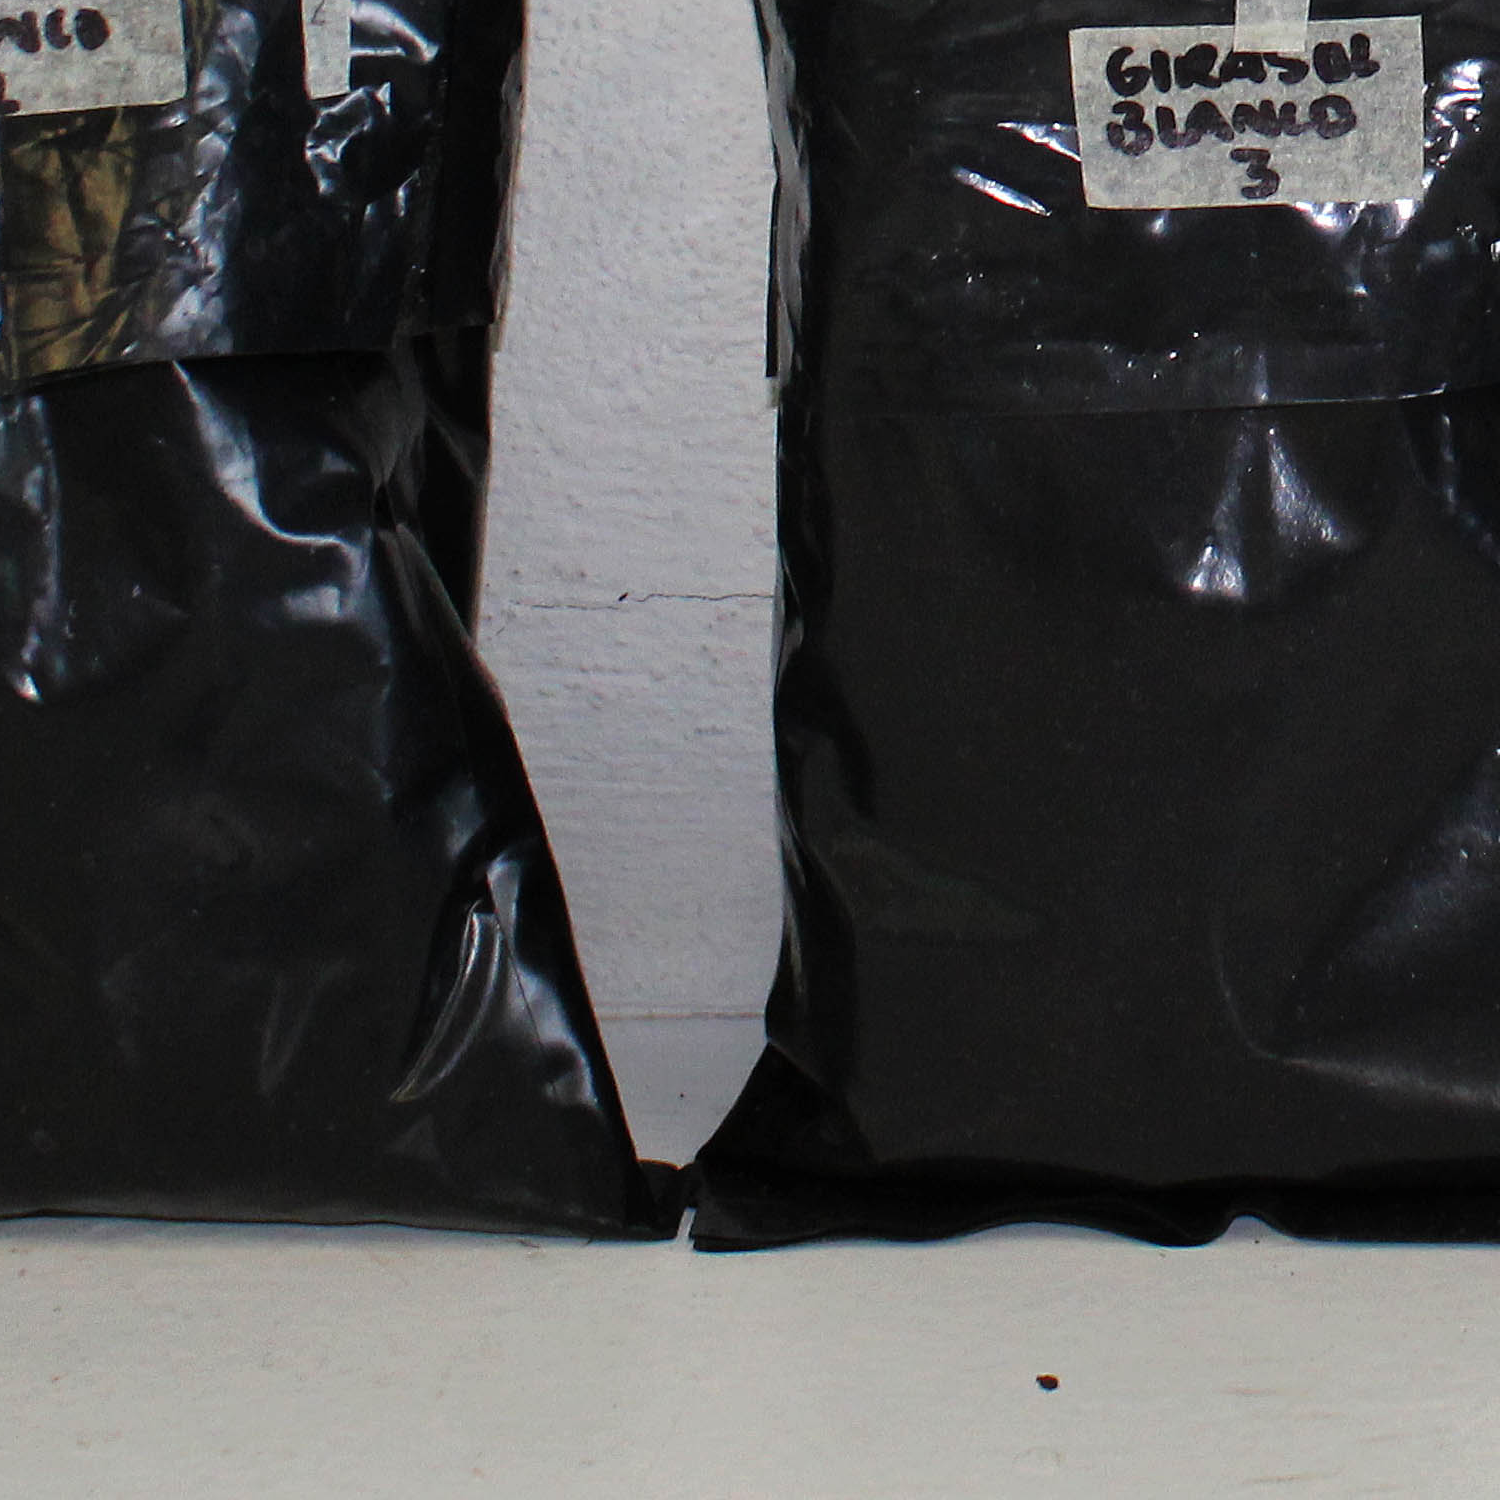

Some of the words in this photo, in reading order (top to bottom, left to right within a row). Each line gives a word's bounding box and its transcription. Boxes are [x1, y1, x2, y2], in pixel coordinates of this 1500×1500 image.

[1106, 33, 1380, 97] GIRASOL
[1106, 94, 1357, 156] BLANCO
[1230, 147, 1280, 199] 3
